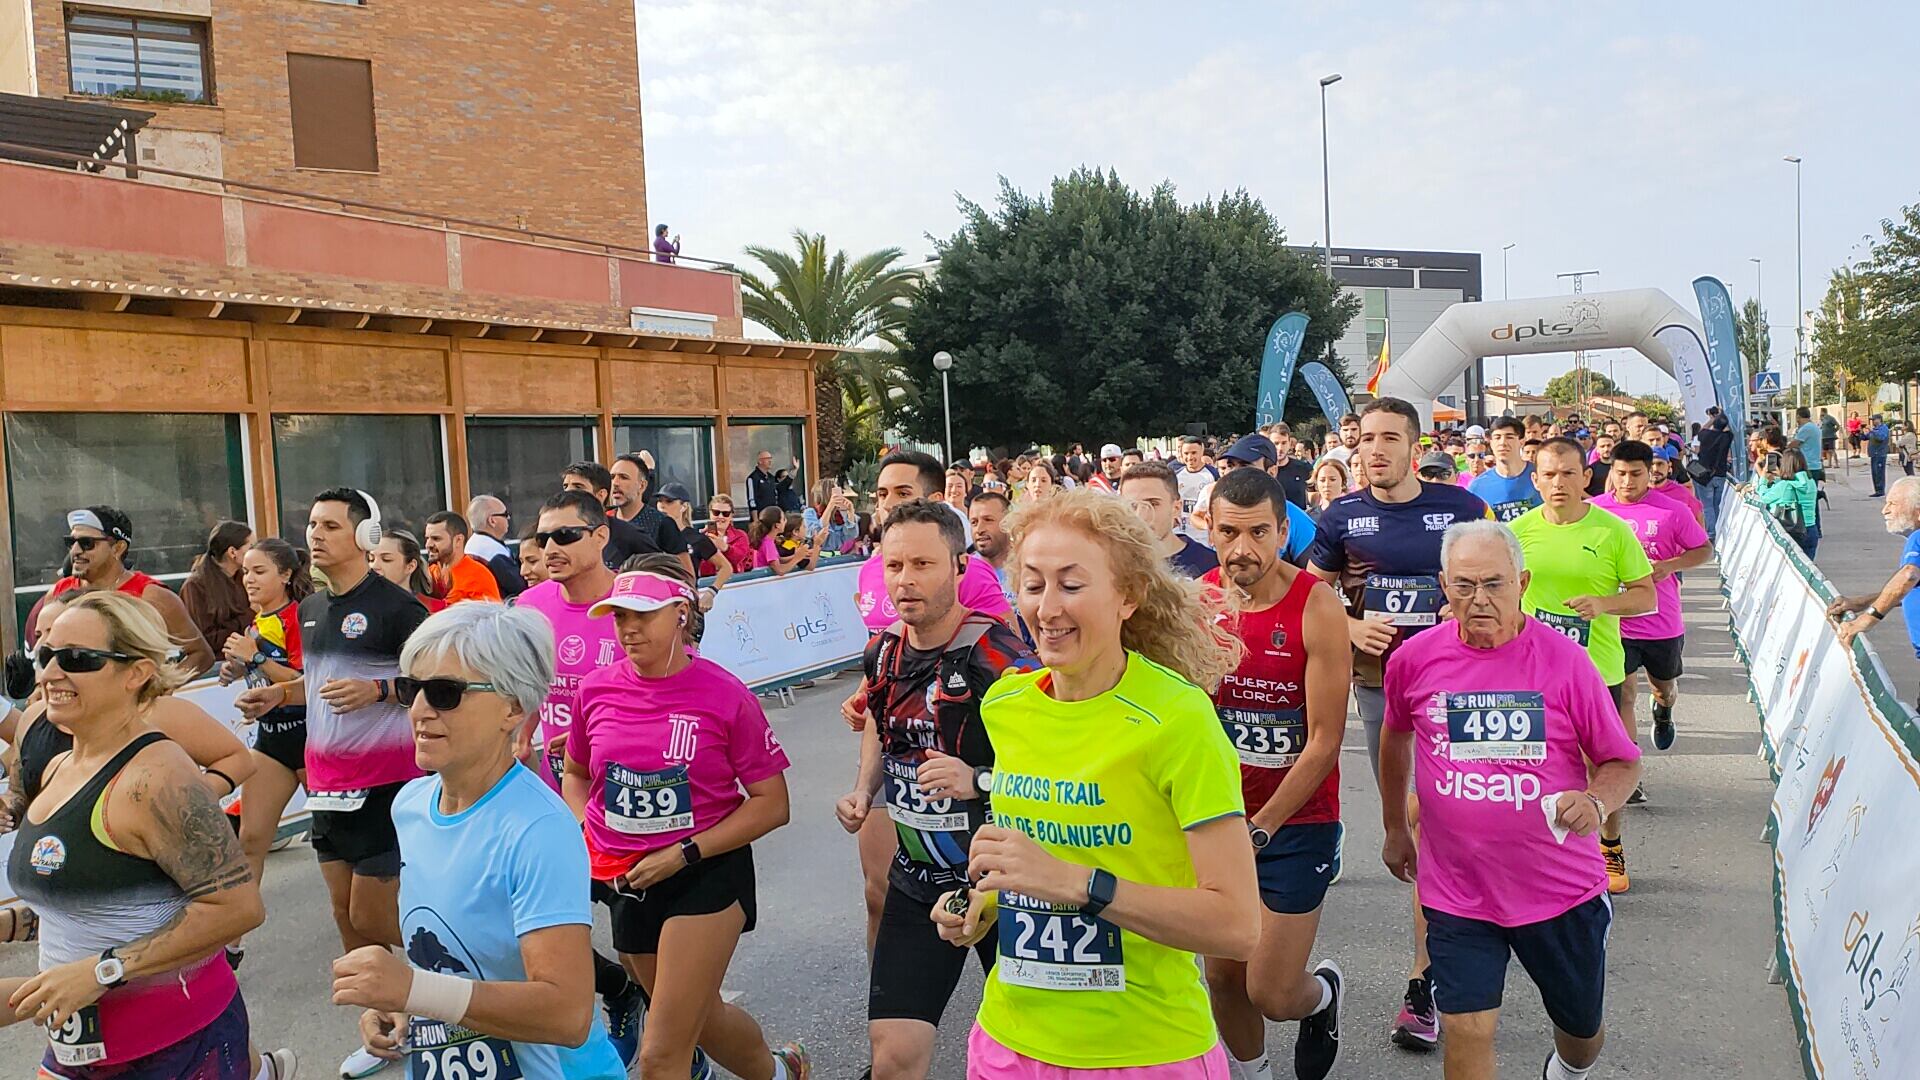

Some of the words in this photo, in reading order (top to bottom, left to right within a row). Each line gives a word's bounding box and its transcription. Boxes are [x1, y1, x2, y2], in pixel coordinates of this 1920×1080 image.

[1491, 318, 1573, 341] dpts
[1347, 516, 1379, 530] LEVEL
[1422, 512, 1455, 525] CEP
[1382, 578, 1402, 589] RUN
[1385, 590, 1418, 613] 67
[783, 616, 827, 642] dpts
[1545, 612, 1563, 624] RUN
[1224, 674, 1298, 691] PUERTAS
[1232, 688, 1290, 704] LORCA
[1468, 694, 1496, 708] RUN
[1236, 710, 1260, 725] RUN
[1463, 710, 1531, 741] 499
[1234, 724, 1292, 754] 235
[620, 769, 643, 788] RUN
[895, 764, 917, 780] RUN
[1005, 774, 1051, 802] CROSS
[1055, 781, 1106, 807] TRAIL
[615, 787, 678, 818] 439
[1015, 816, 1035, 839] DE
[1036, 819, 1132, 848] BOLNUEVO
[1015, 912, 1102, 963] 242
[1843, 910, 1883, 1011] dpts
[421, 1023, 448, 1046] RUN
[420, 1041, 498, 1080] 269
